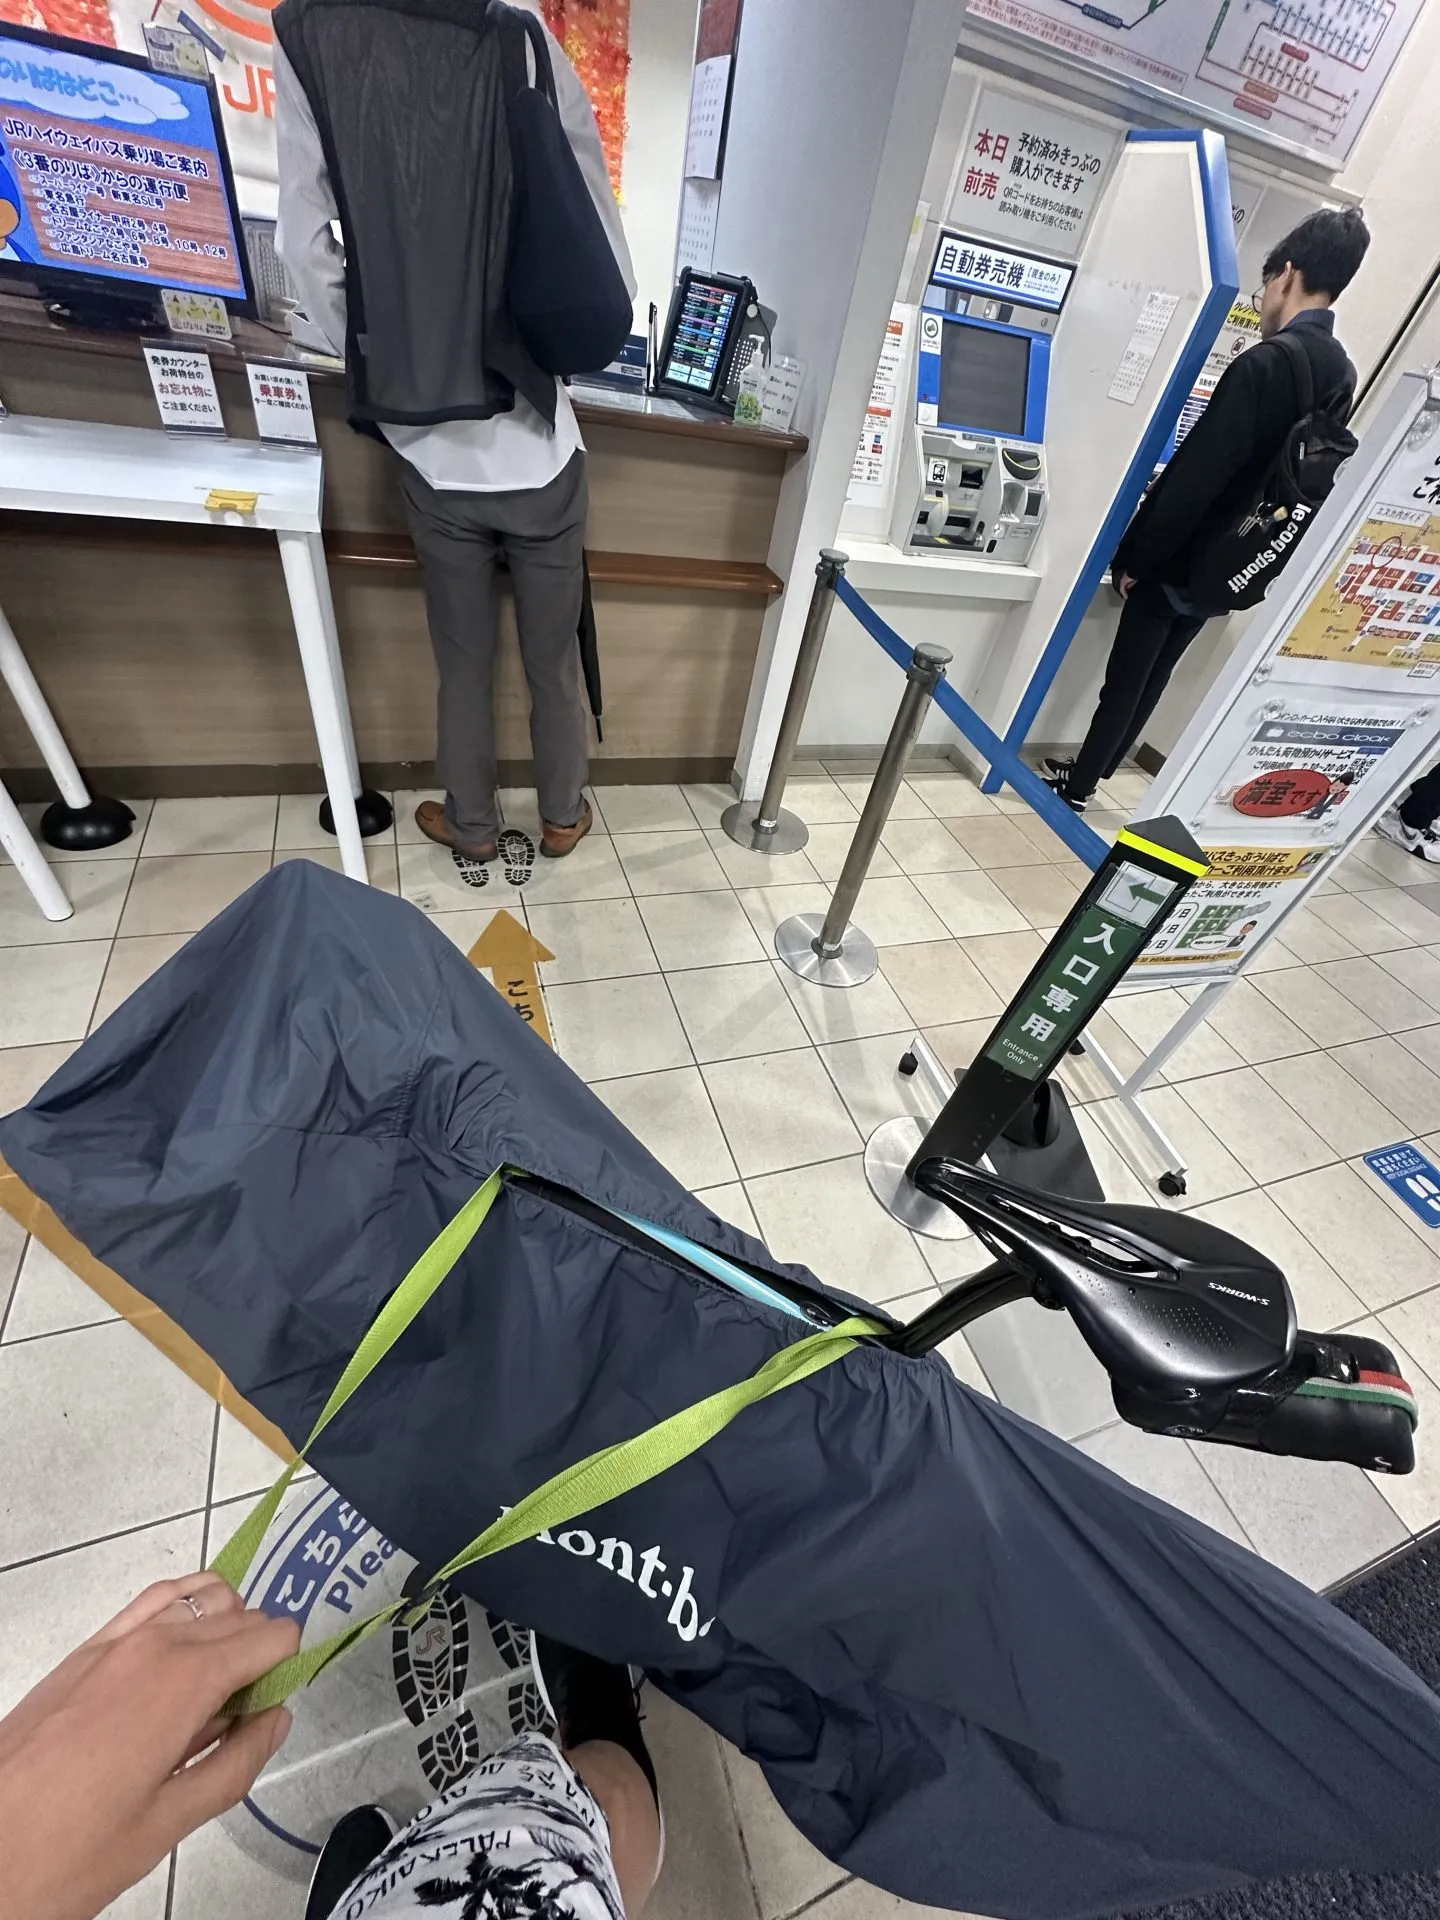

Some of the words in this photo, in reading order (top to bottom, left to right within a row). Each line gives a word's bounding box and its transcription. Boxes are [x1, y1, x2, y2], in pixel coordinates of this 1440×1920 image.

[5, 118, 208, 177] JRハイウェイバス乗り場ご案内
[974, 128, 1009, 163] 本日
[1018, 132, 1101, 175] 予約済みきっぷの
[963, 166, 1000, 200] 前売
[1009, 155, 1084, 195] 購入ができます
[940, 245, 1025, 289] 自動券売機
[151, 355, 207, 368] 発券カウンター
[161, 368, 204, 380] お荷物台の
[158, 383, 213, 397] お忘れ物に
[162, 401, 217, 413] ご注意ください
[1291, 503, 1312, 521] le
[1270, 521, 1298, 553] coq
[1227, 549, 1277, 593] sportif
[1287, 728, 1339, 740] ecbo
[1342, 730, 1392, 742] cloak
[1238, 779, 1322, 806] 満室です
[1020, 922, 1116, 1042] 入口専用
[1002, 1038, 1039, 1062] Entrance
[1006, 1052, 1026, 1066] Only
[1207, 1281, 1270, 1306] S-WORKS
